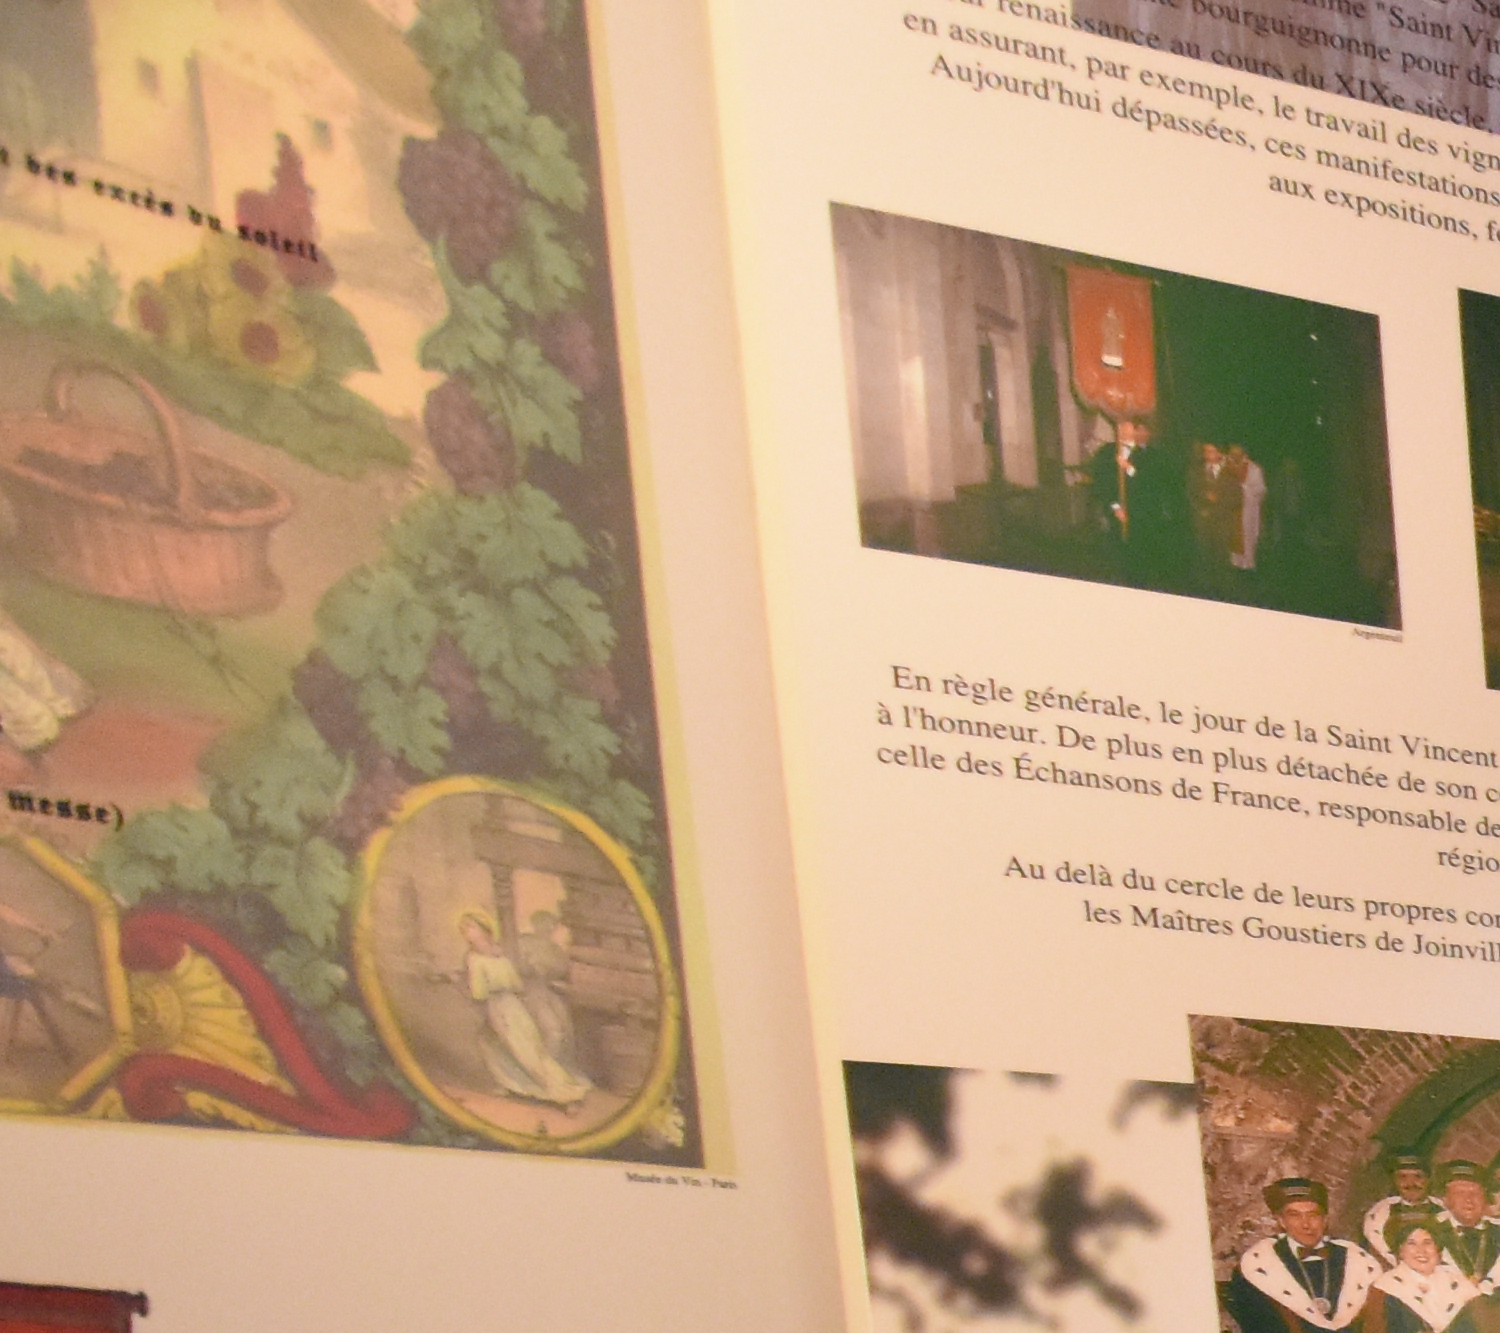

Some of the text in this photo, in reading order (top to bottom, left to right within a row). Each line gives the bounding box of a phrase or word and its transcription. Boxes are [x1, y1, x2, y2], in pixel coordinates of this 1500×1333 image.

[891, 664, 932, 692] En
[941, 673, 1013, 706] règle
[1024, 686, 1150, 722] générale,
[1158, 700, 1183, 725] le
[1190, 705, 1246, 734] jour
[1254, 714, 1285, 739] de
[1293, 718, 1318, 743] la
[1326, 724, 1392, 754] Saint
[1399, 733, 1498, 769] Vincent
